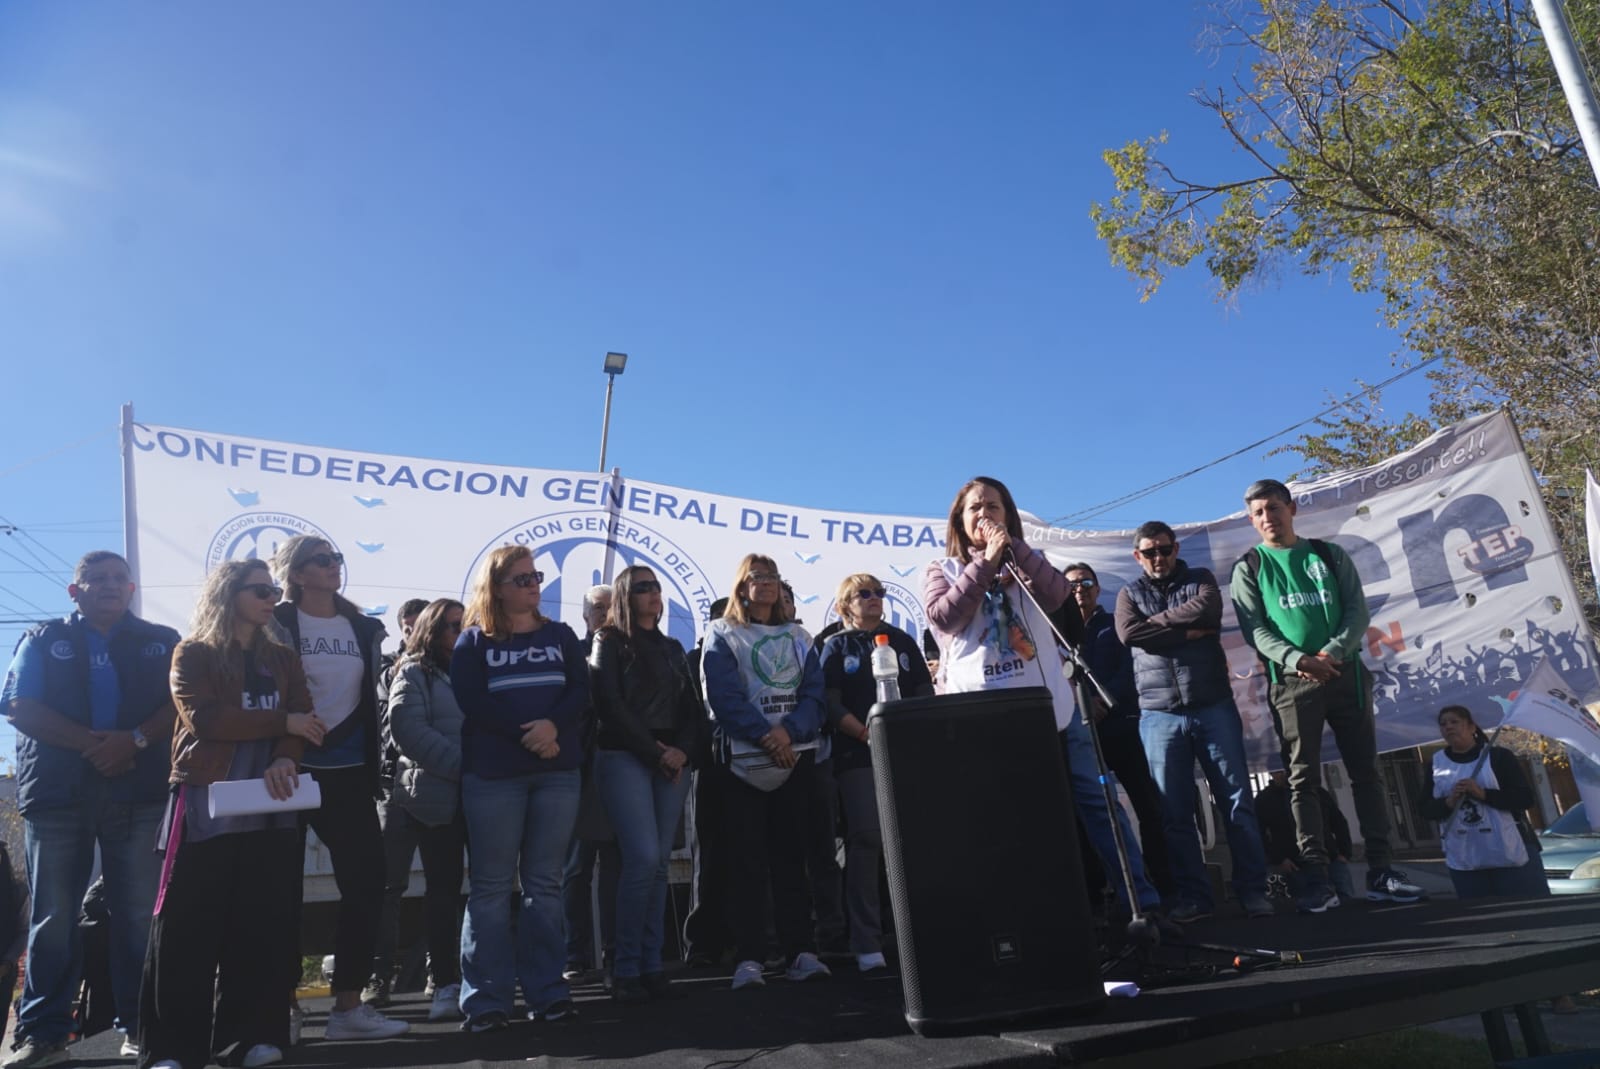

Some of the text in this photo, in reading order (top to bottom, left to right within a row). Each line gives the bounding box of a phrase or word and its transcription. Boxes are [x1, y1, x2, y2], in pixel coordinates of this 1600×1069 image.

[131, 423, 947, 549] CONFEDERACION GENERAL DEL TRABA
[256, 514, 308, 533] GENERAL
[569, 516, 660, 556] GENERAL
[664, 553, 697, 586] DEL
[1456, 524, 1523, 566] TEP
[486, 644, 564, 667] UPCN
[984, 658, 1025, 676] aten
